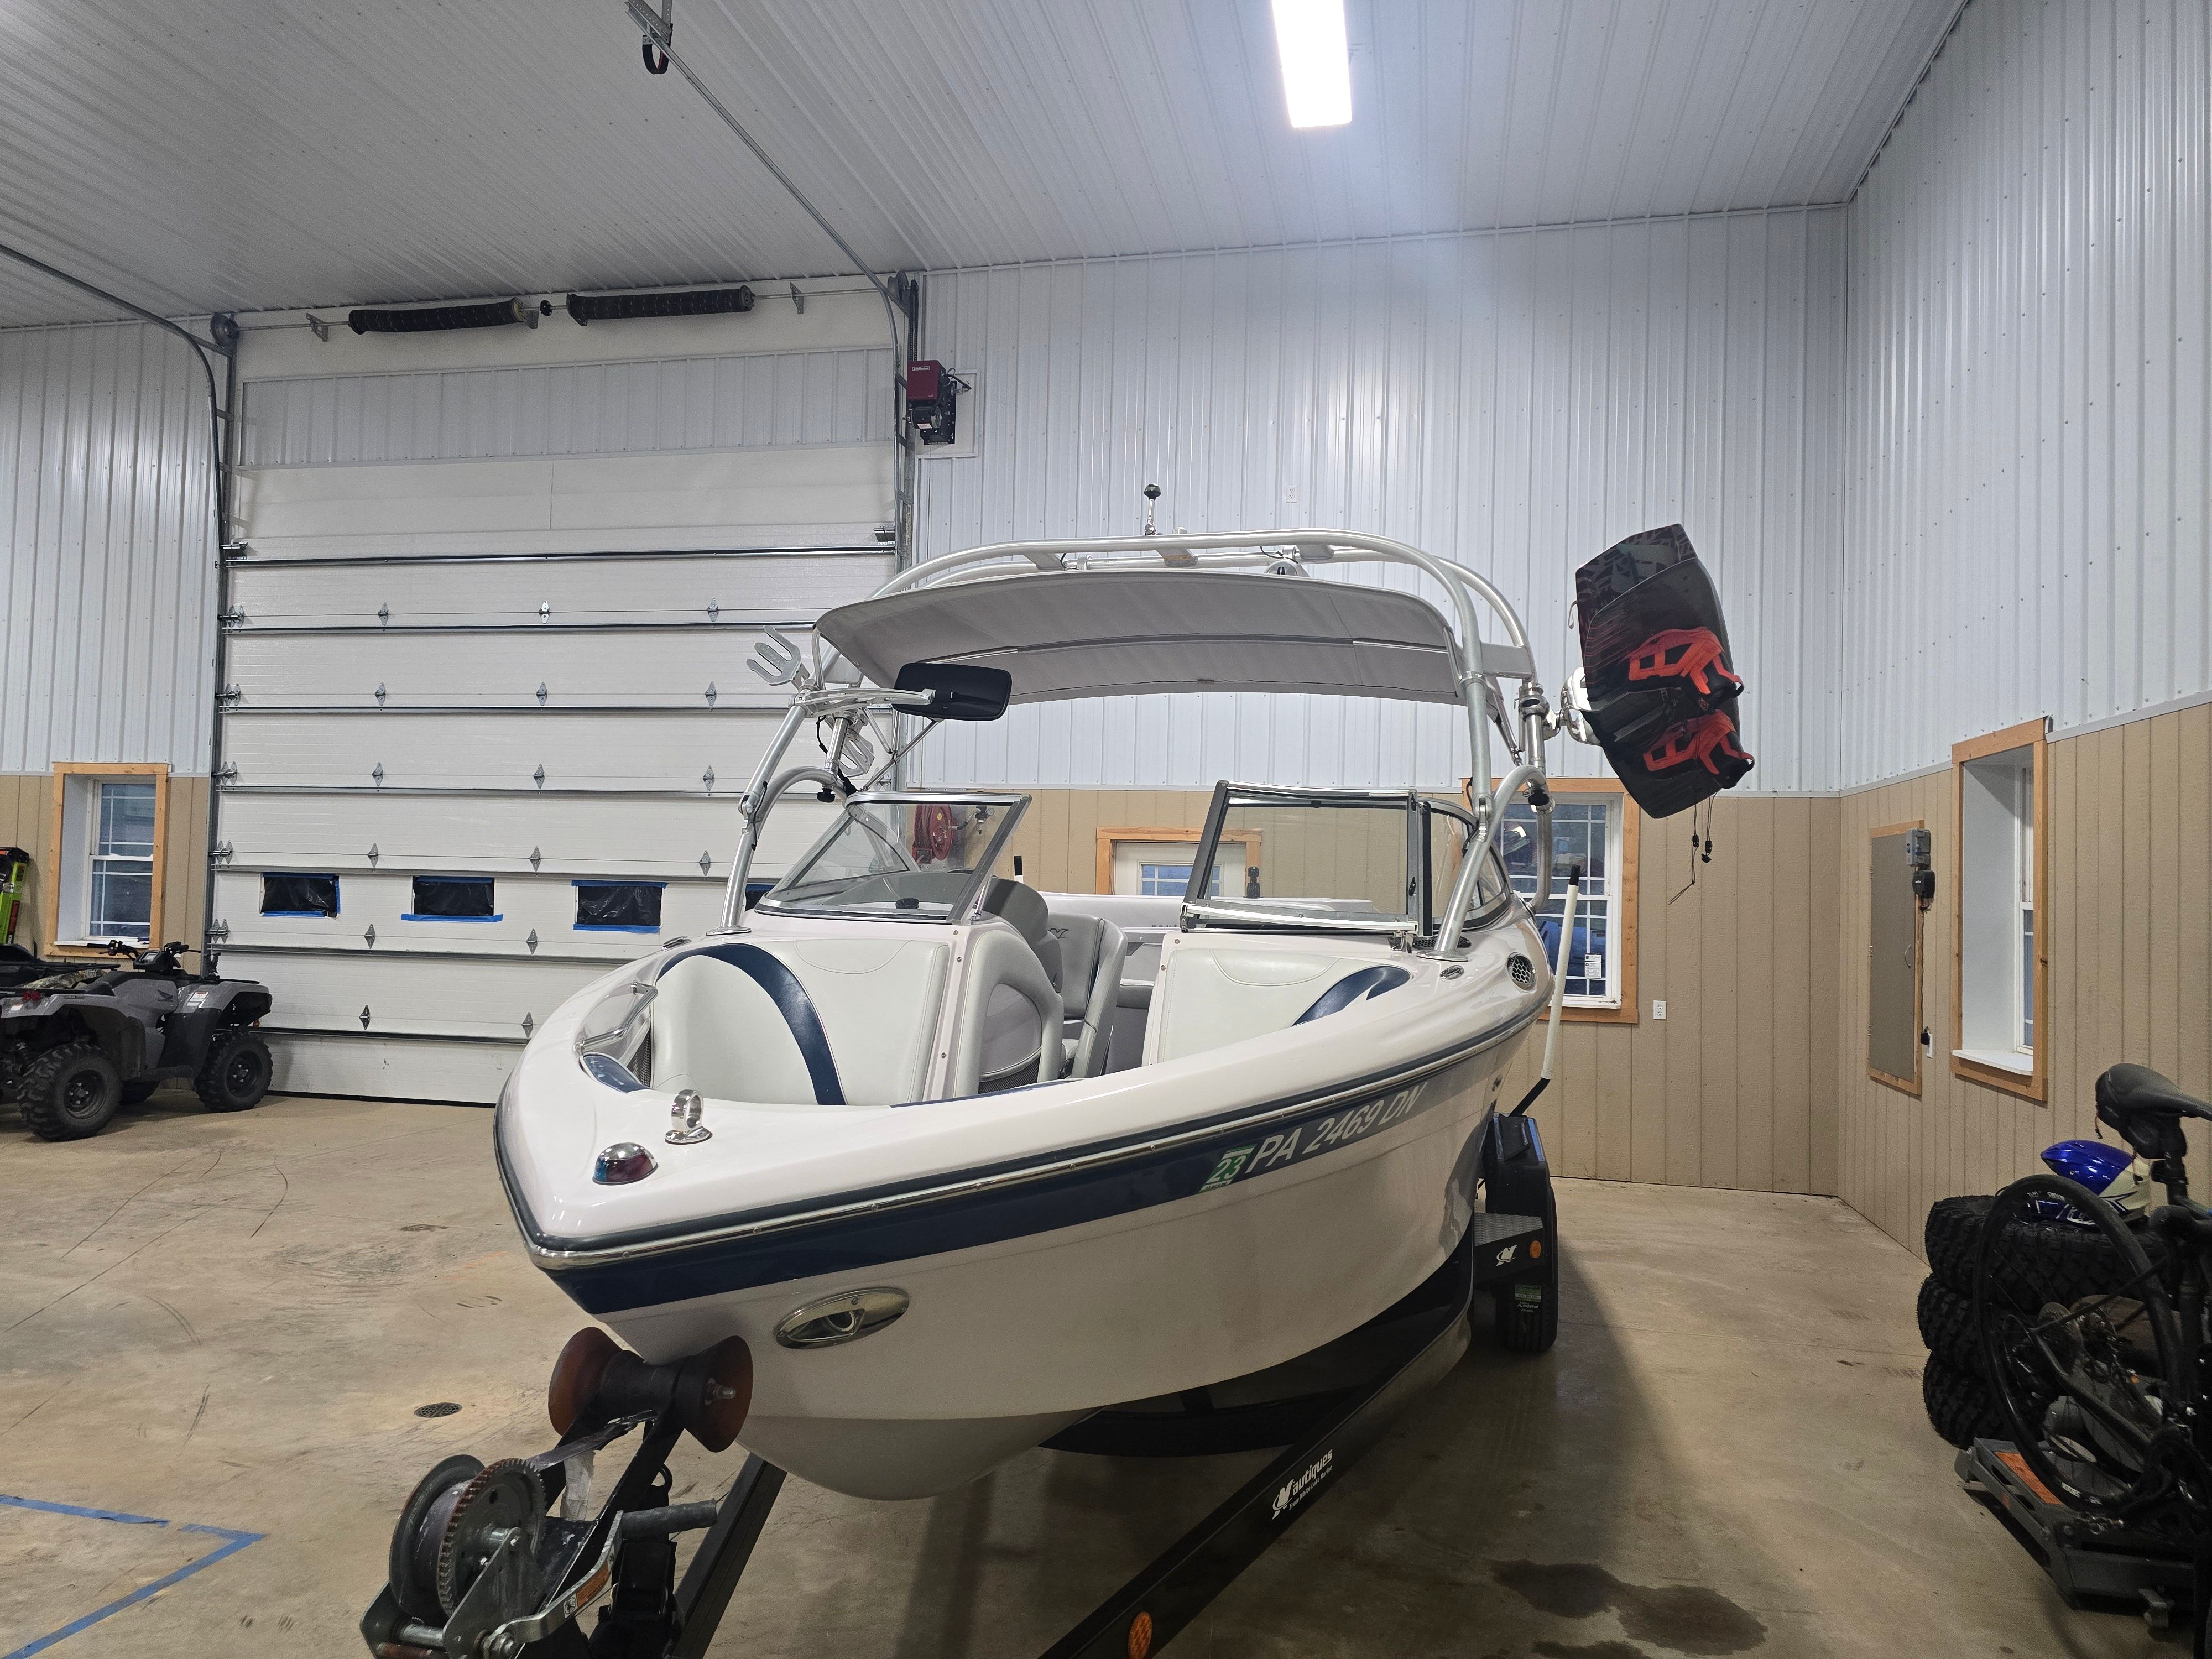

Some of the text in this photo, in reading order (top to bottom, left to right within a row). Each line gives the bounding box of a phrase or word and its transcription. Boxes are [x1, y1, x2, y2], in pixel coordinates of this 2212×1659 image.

[1244, 1082, 1429, 1174] PA 2469 DN
[1205, 1155, 1246, 1184] 23
[1272, 1448, 1333, 1520] Nautiques
